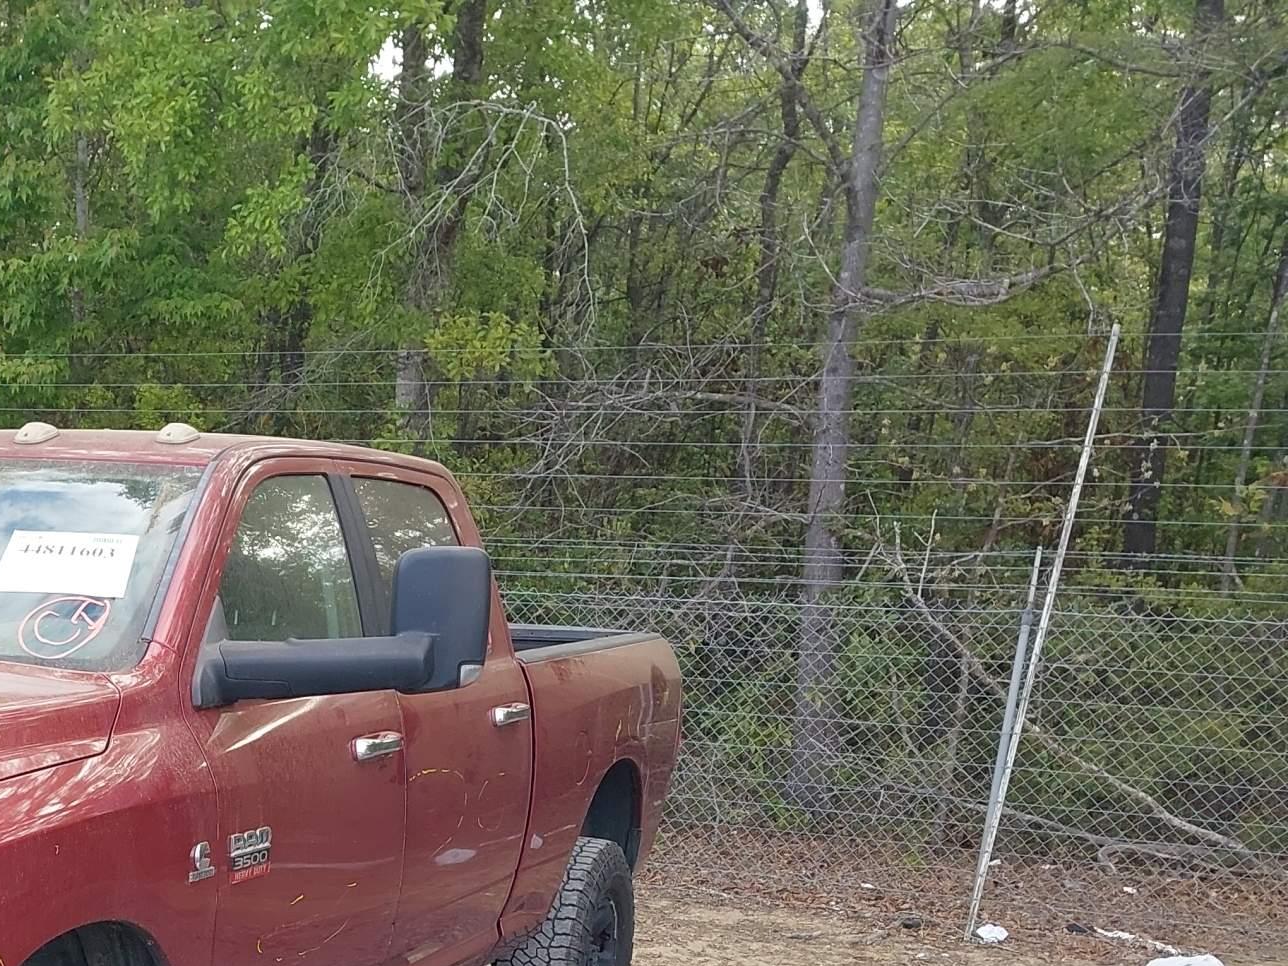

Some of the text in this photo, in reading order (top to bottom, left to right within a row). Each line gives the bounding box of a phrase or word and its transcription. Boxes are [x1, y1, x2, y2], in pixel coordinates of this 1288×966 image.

[233, 851, 268, 870] 3500
[234, 863, 267, 881] HEAVY DUTY
